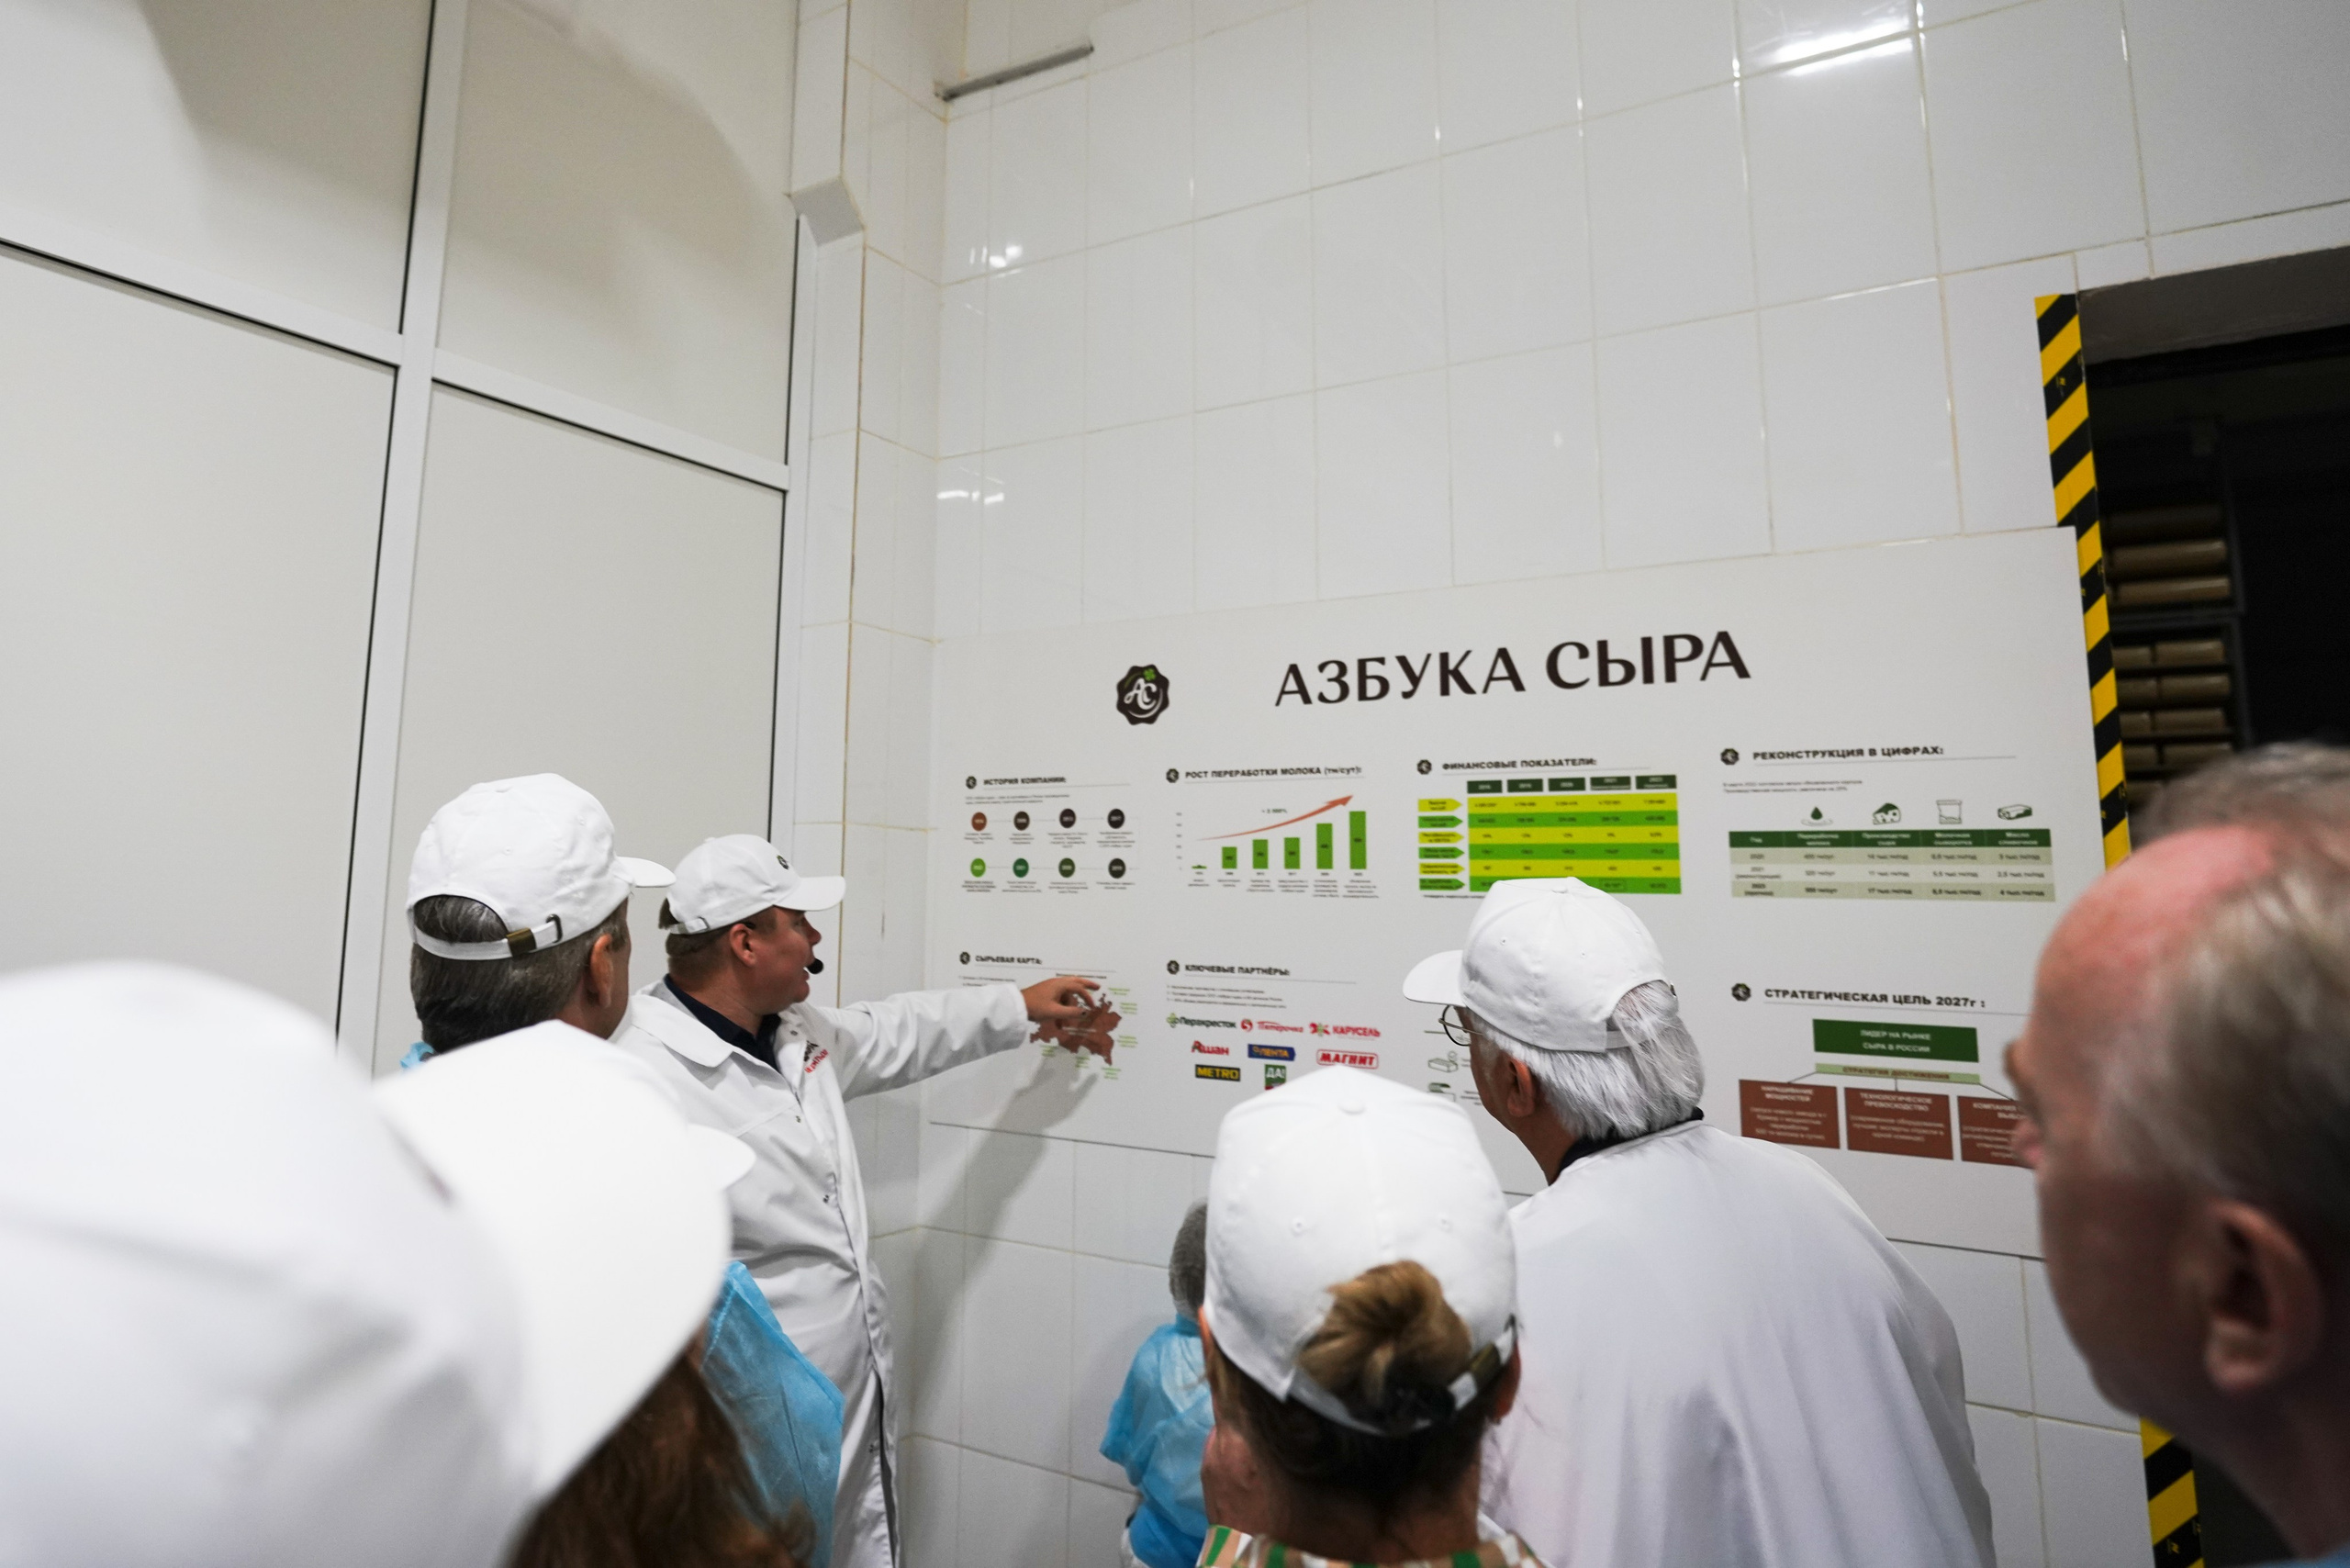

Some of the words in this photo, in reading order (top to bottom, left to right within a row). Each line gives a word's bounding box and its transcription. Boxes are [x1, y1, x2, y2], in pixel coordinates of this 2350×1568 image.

[1275, 647, 1526, 706] АЗБУКА
[1545, 631, 1751, 689] СЫРА
[1753, 748, 1864, 760] РЕКОНСТРУКЦИЯ
[1868, 748, 1877, 757] В
[1882, 745, 1944, 758] ЦИФРАХ:
[1442, 760, 1517, 770] ФИНАНСОВЫЕ
[1520, 758, 1597, 768] ПОКАЗАТЕЛИ:
[1211, 768, 1278, 778] ПЕРЕРАБОТКИ
[1281, 767, 1321, 777] МОЛОКА
[975, 956, 1015, 964] СЫРЬЕВАЯ
[1185, 964, 1236, 974] КЛЮЧЕВЫЕ
[1764, 989, 1888, 1003] СТРАТЕГИЧЕСКАЯ
[1892, 994, 1931, 1006] ЦЕЛЬ
[1936, 996, 1976, 1008] 2027г
[1333, 1025, 1381, 1037] КАРУСЕЛЬ
[1319, 1053, 1375, 1066] МАГНИТ
[1196, 1066, 1239, 1081] METRO
